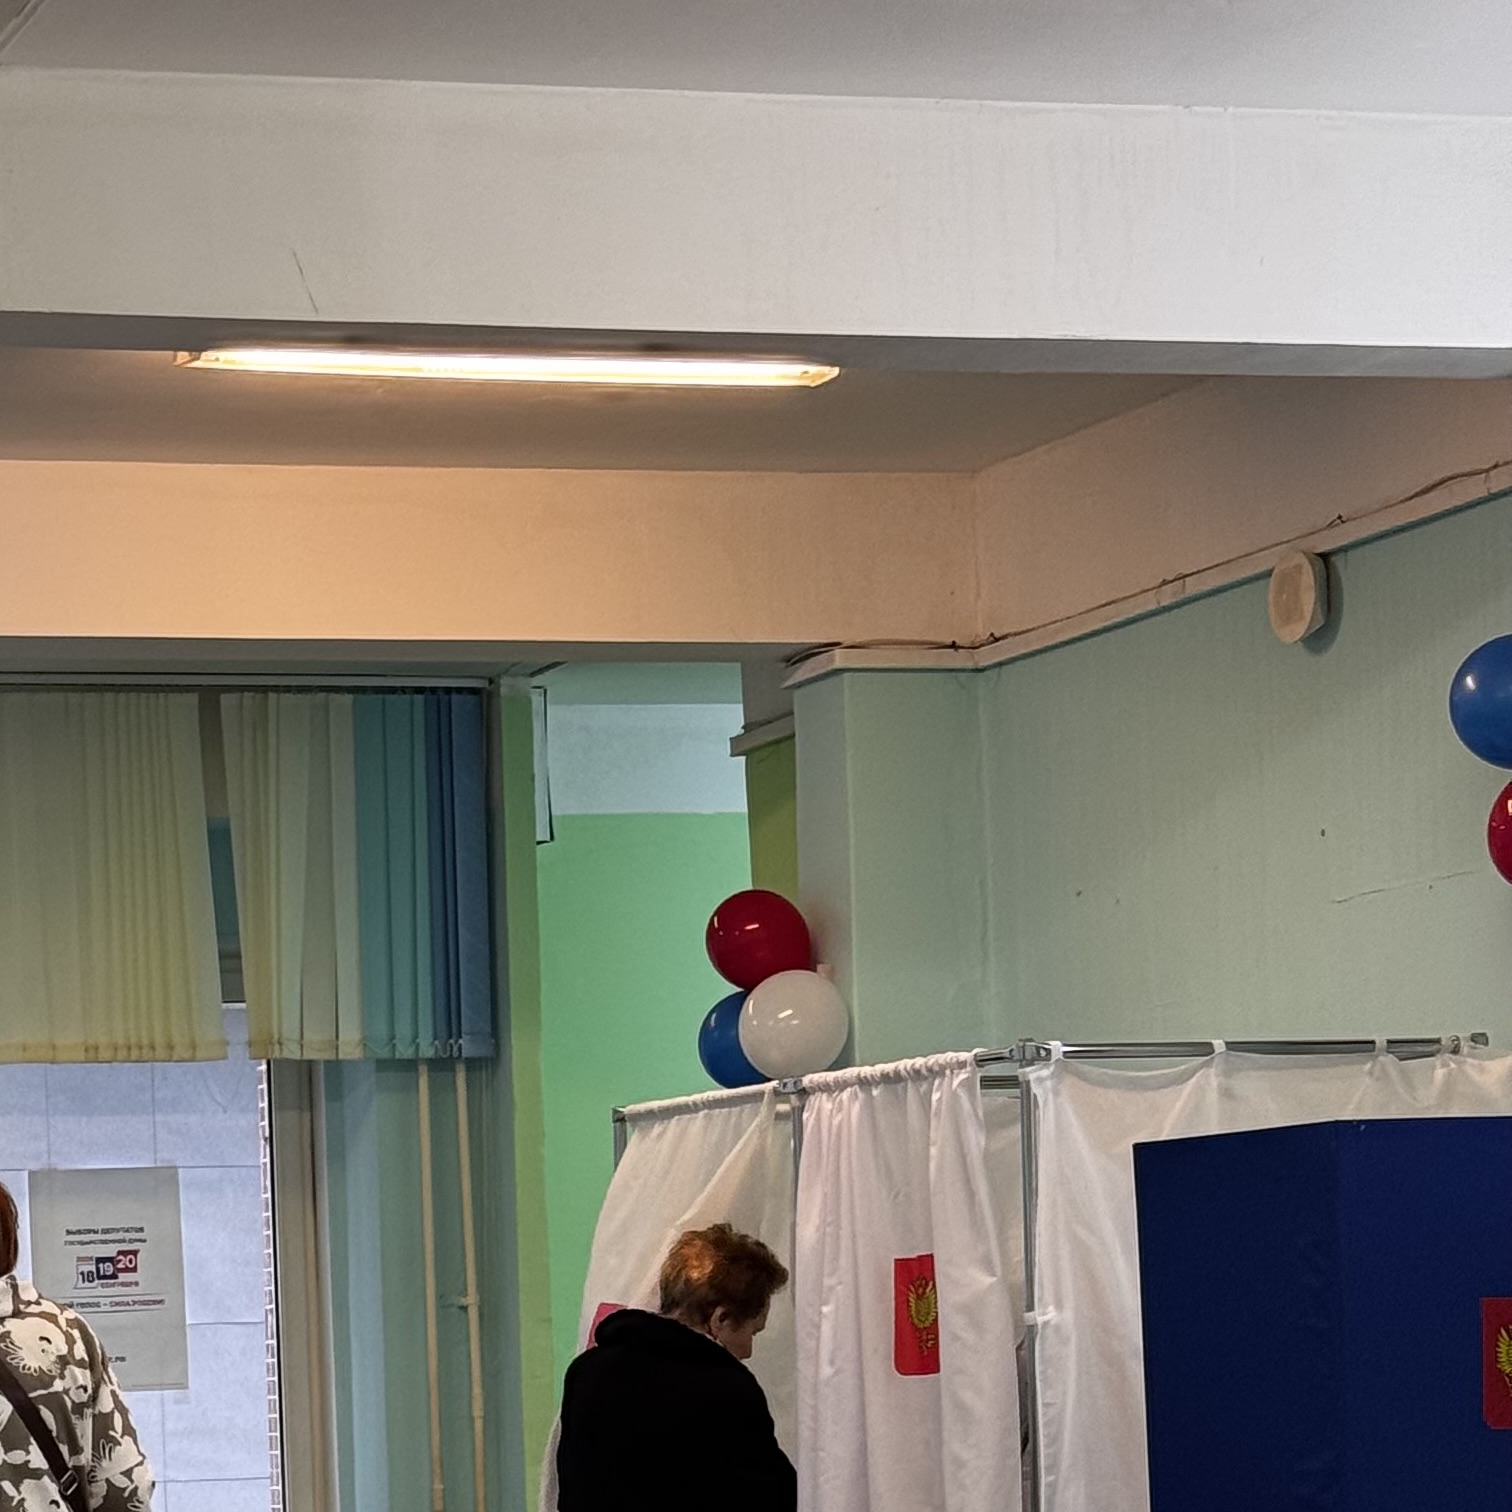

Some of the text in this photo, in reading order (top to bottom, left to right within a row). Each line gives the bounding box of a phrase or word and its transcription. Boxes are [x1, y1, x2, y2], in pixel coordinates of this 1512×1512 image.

[79, 1254, 136, 1284] 18 19 20
